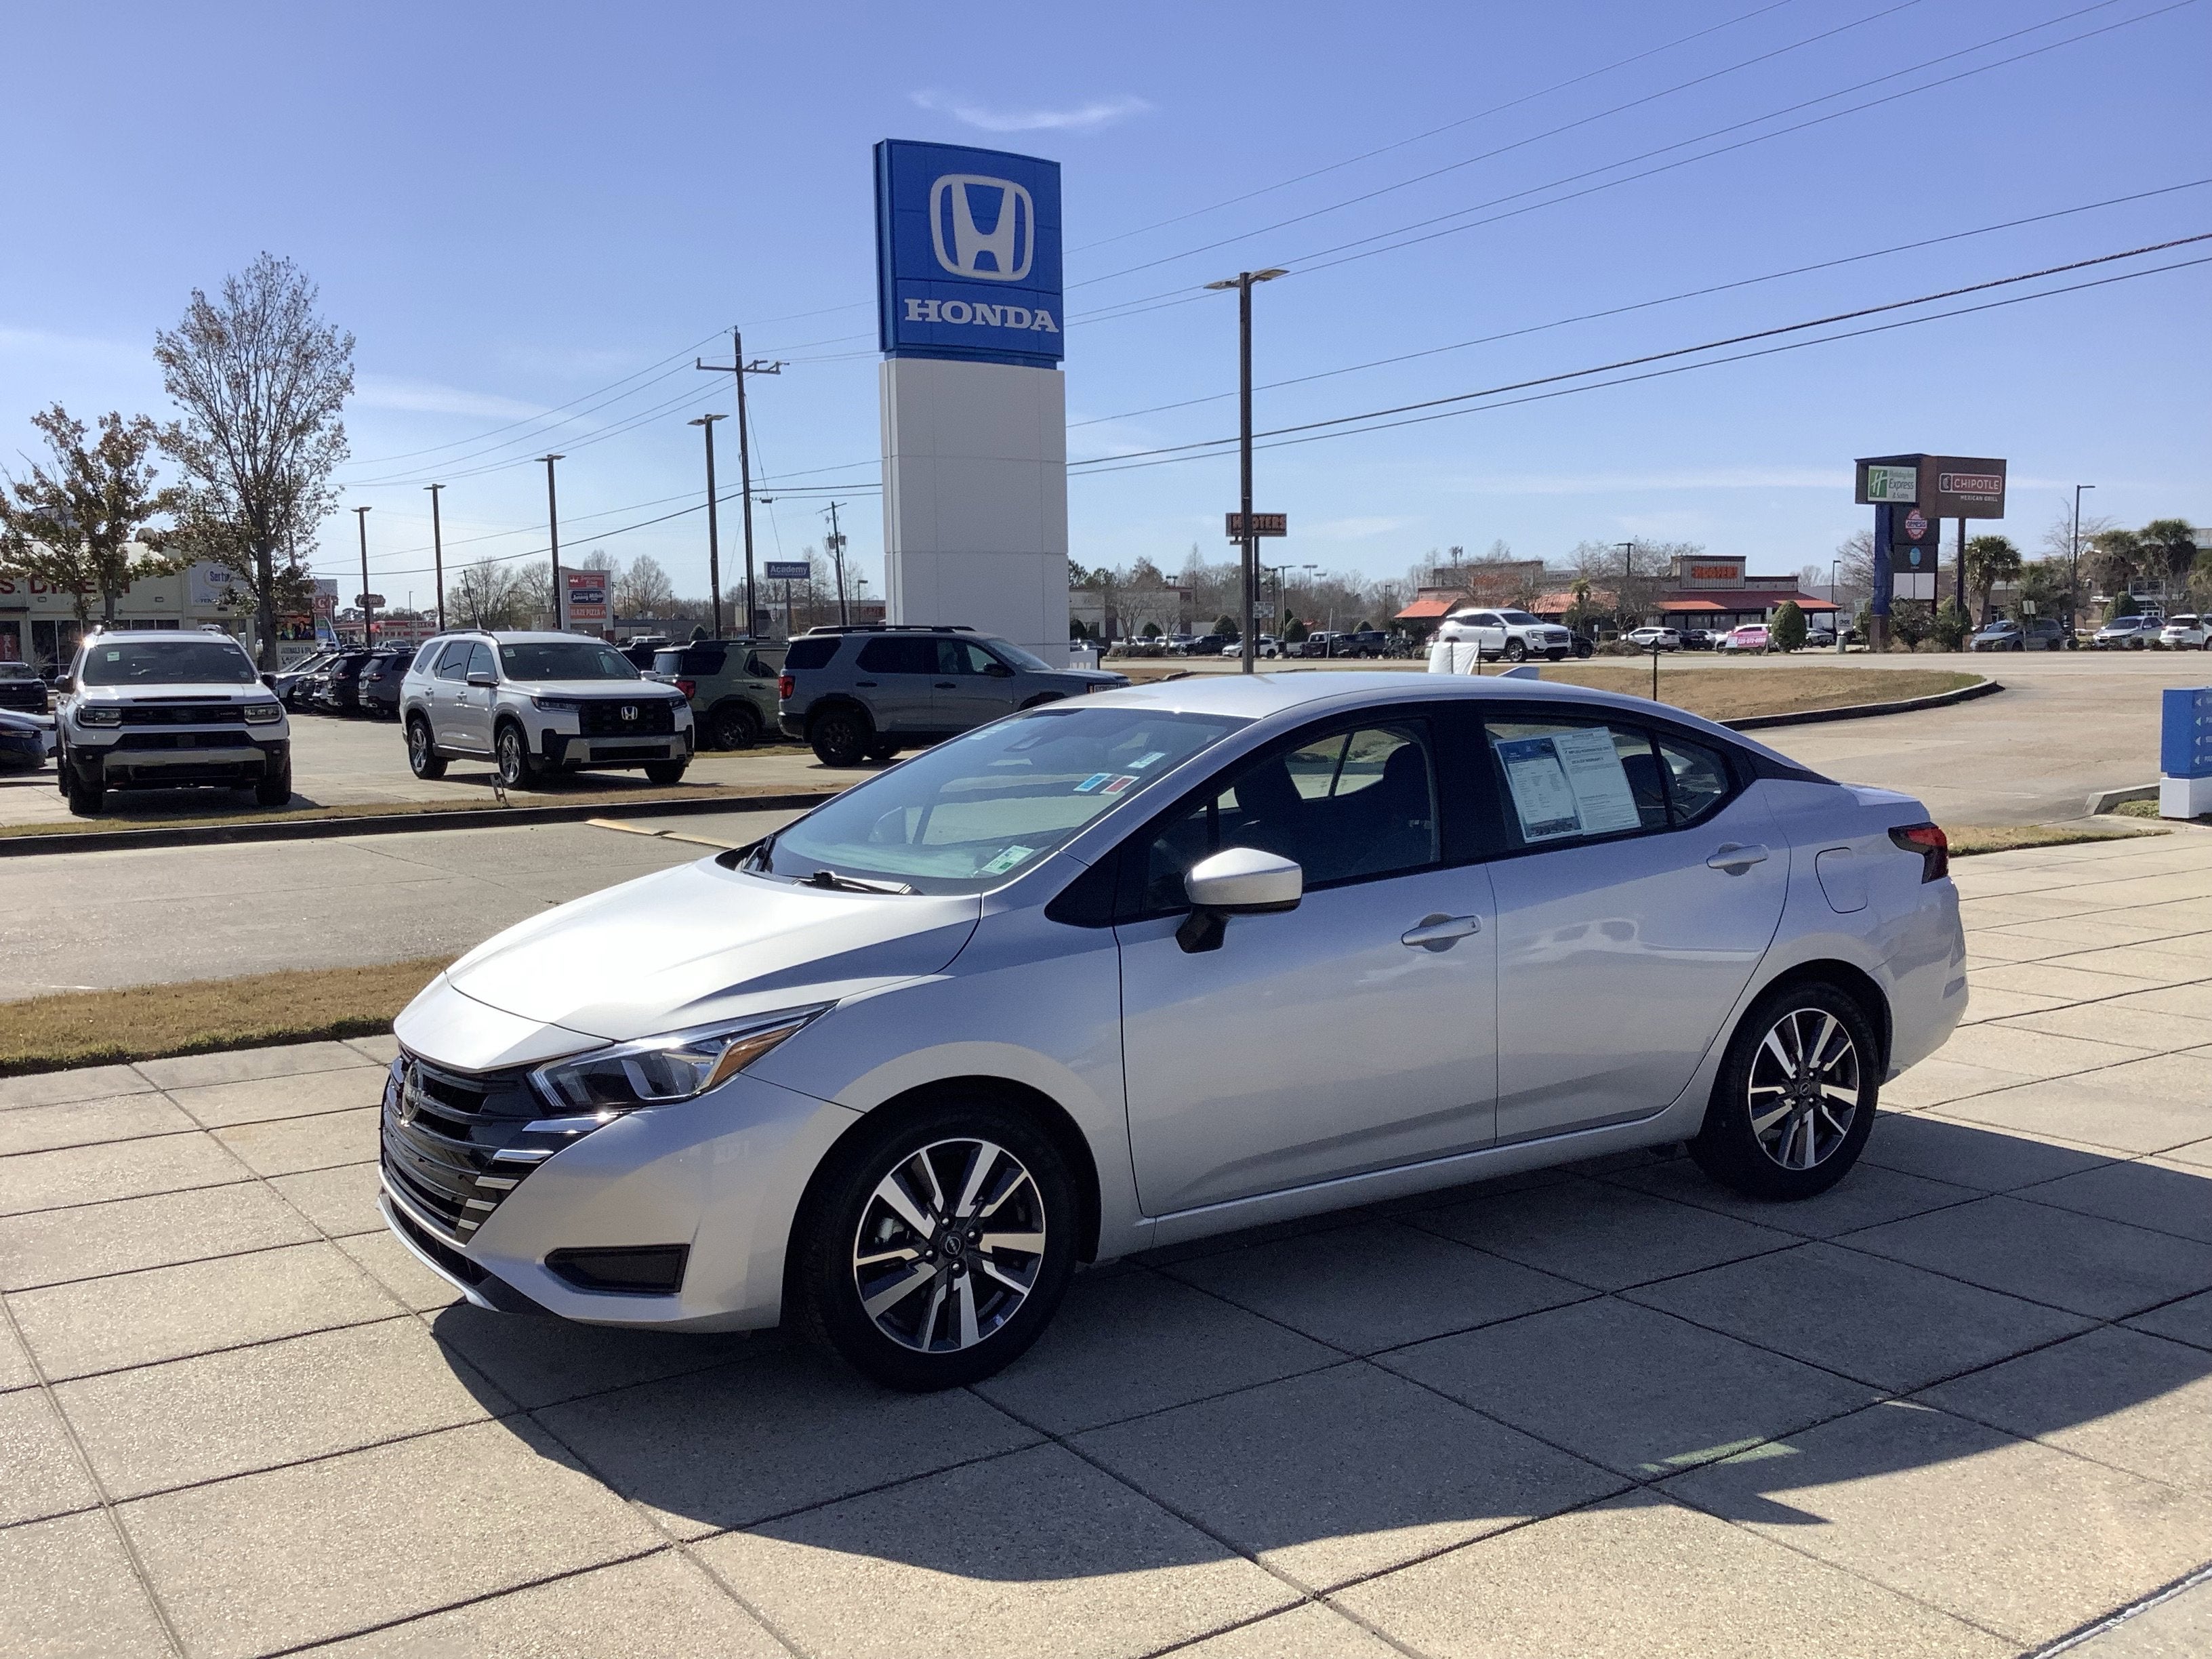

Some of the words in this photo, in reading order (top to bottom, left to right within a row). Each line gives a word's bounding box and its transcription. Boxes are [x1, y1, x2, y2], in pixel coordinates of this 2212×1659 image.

[904, 298, 1059, 333] HONDA
[1889, 478, 1914, 491] Express
[1954, 478, 1999, 489] CHIPOTLE
[1233, 516, 1285, 529] HOTERS
[771, 565, 808, 575] Academy
